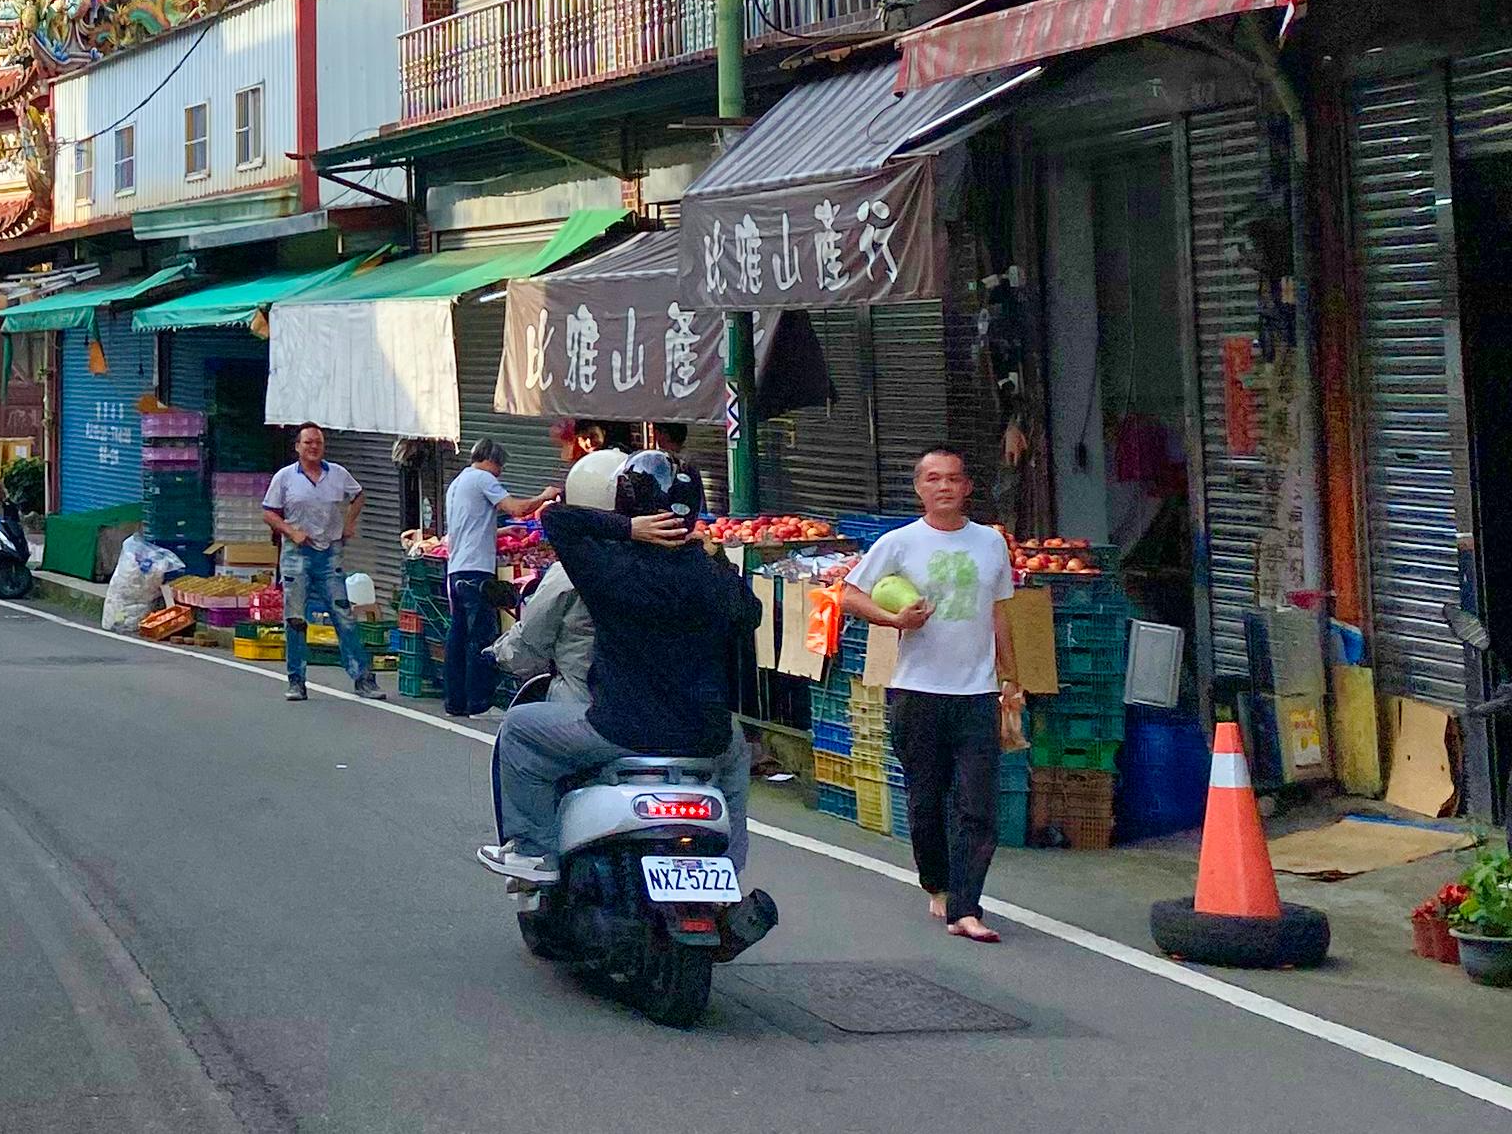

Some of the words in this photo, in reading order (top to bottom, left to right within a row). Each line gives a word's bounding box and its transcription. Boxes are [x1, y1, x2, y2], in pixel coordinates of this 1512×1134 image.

[702, 197, 899, 296] 比雅山產行
[524, 301, 766, 400] 比雅山產
